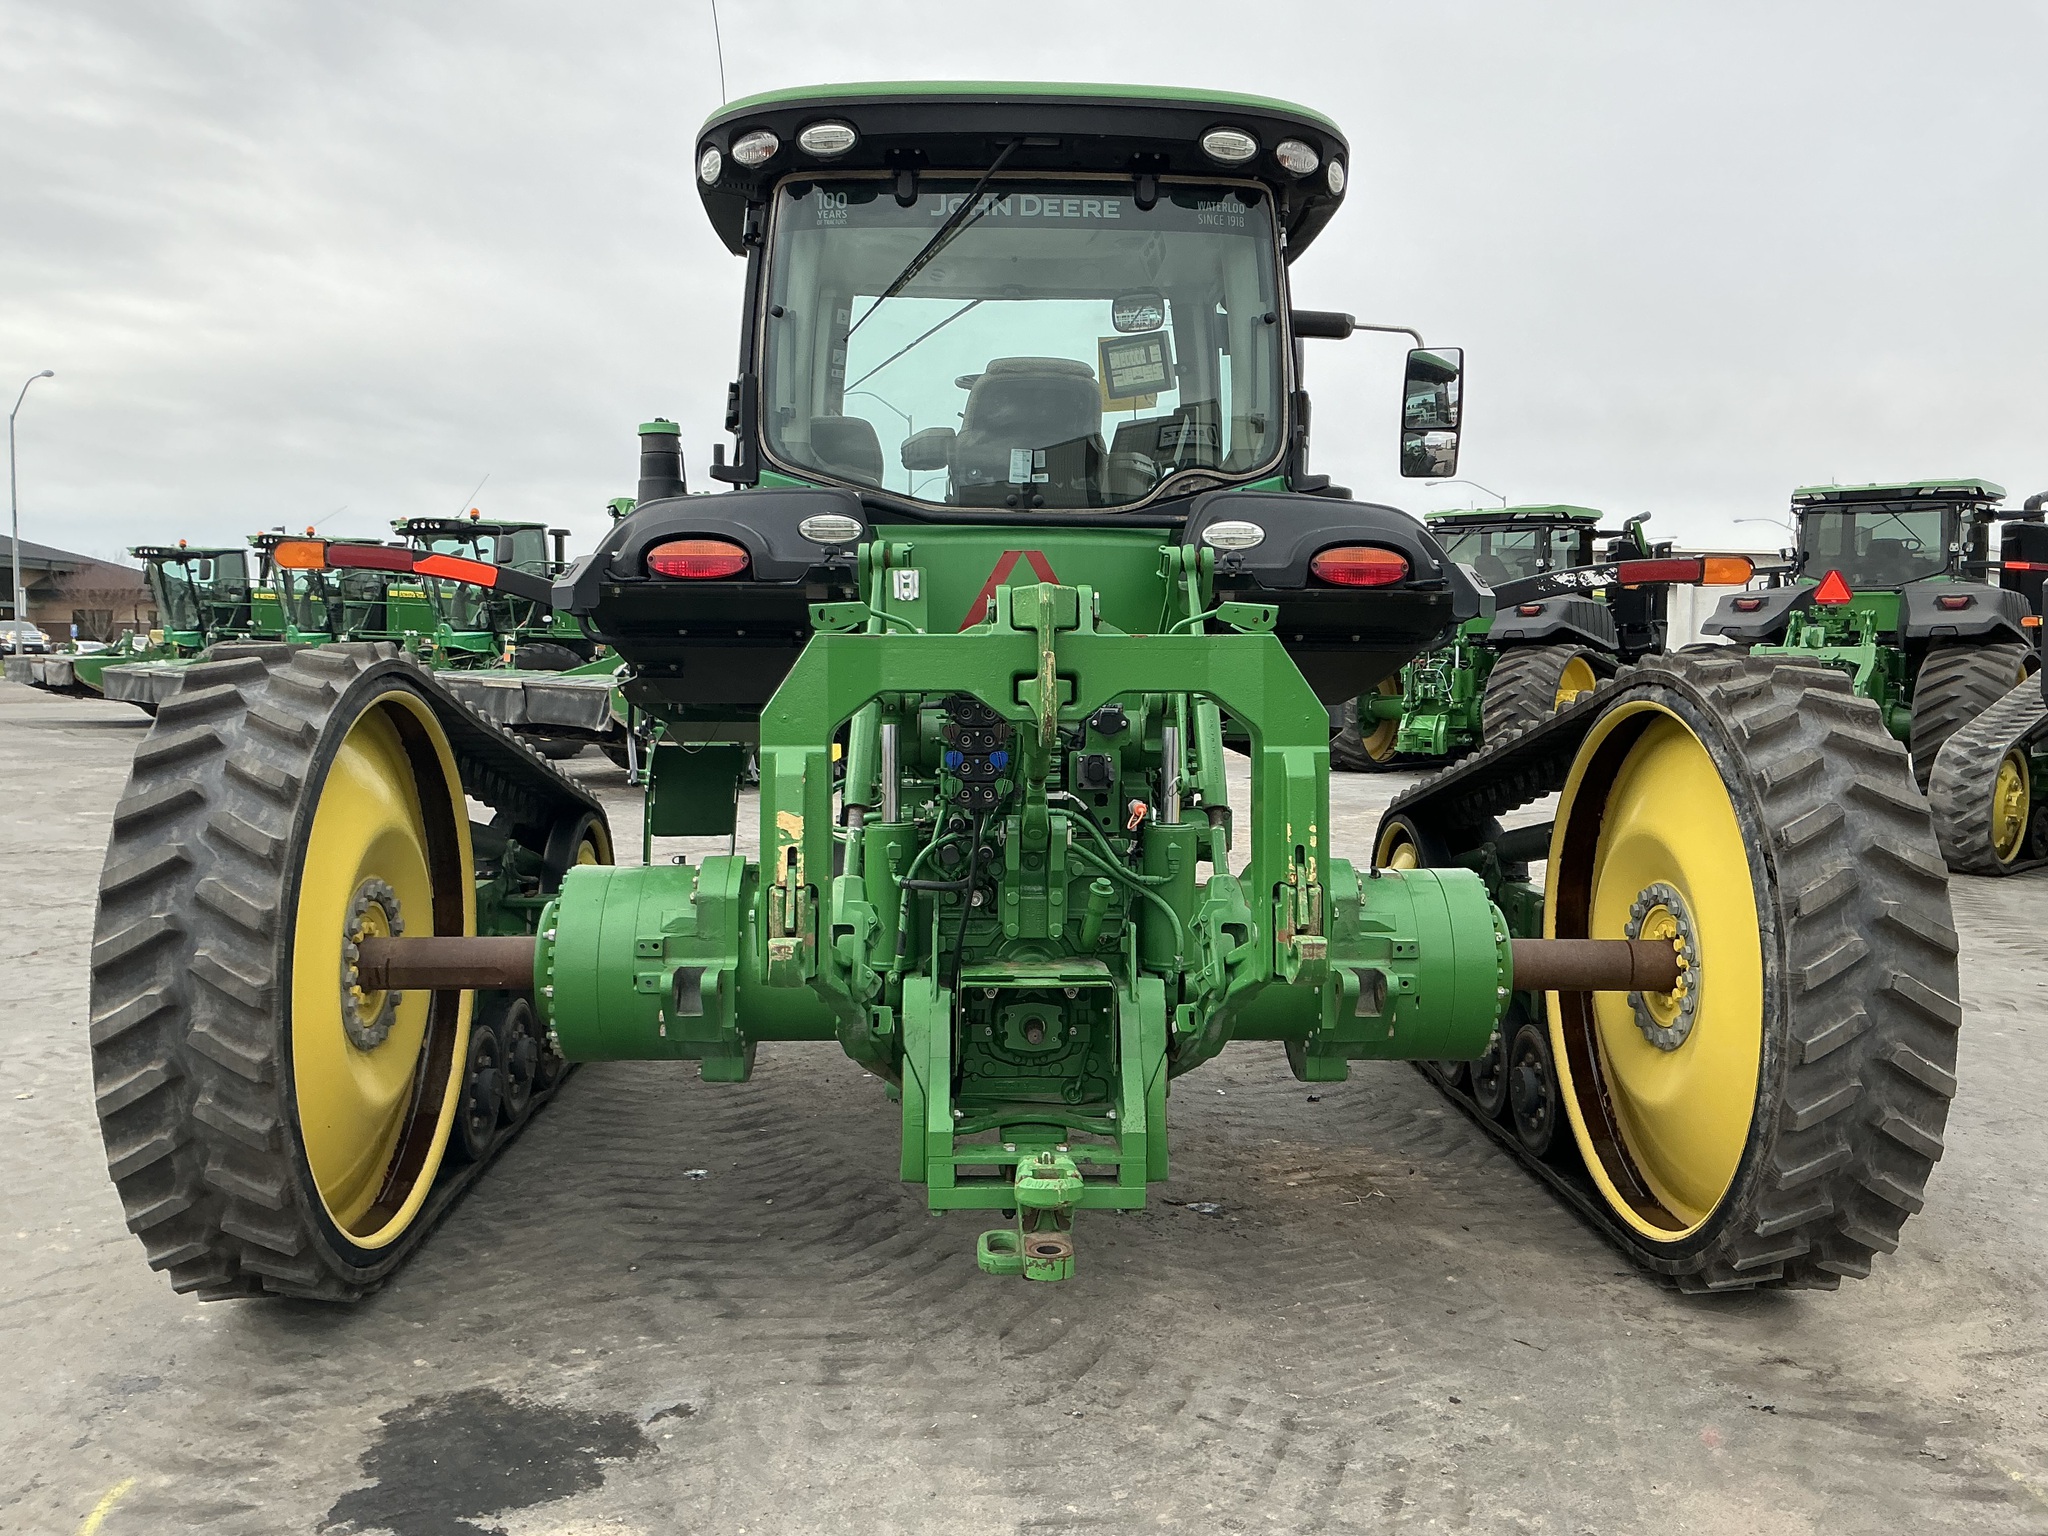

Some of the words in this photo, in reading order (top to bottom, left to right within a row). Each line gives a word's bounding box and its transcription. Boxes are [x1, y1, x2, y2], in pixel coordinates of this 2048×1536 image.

[817, 192, 848, 209] 100
[930, 194, 1012, 216] JOHN
[1020, 194, 1121, 219] DEERE
[1197, 200, 1245, 214] WATERLOO
[817, 209, 848, 219] YEARS
[1198, 213, 1225, 226] SINCE
[1227, 215, 1245, 227] 1918
